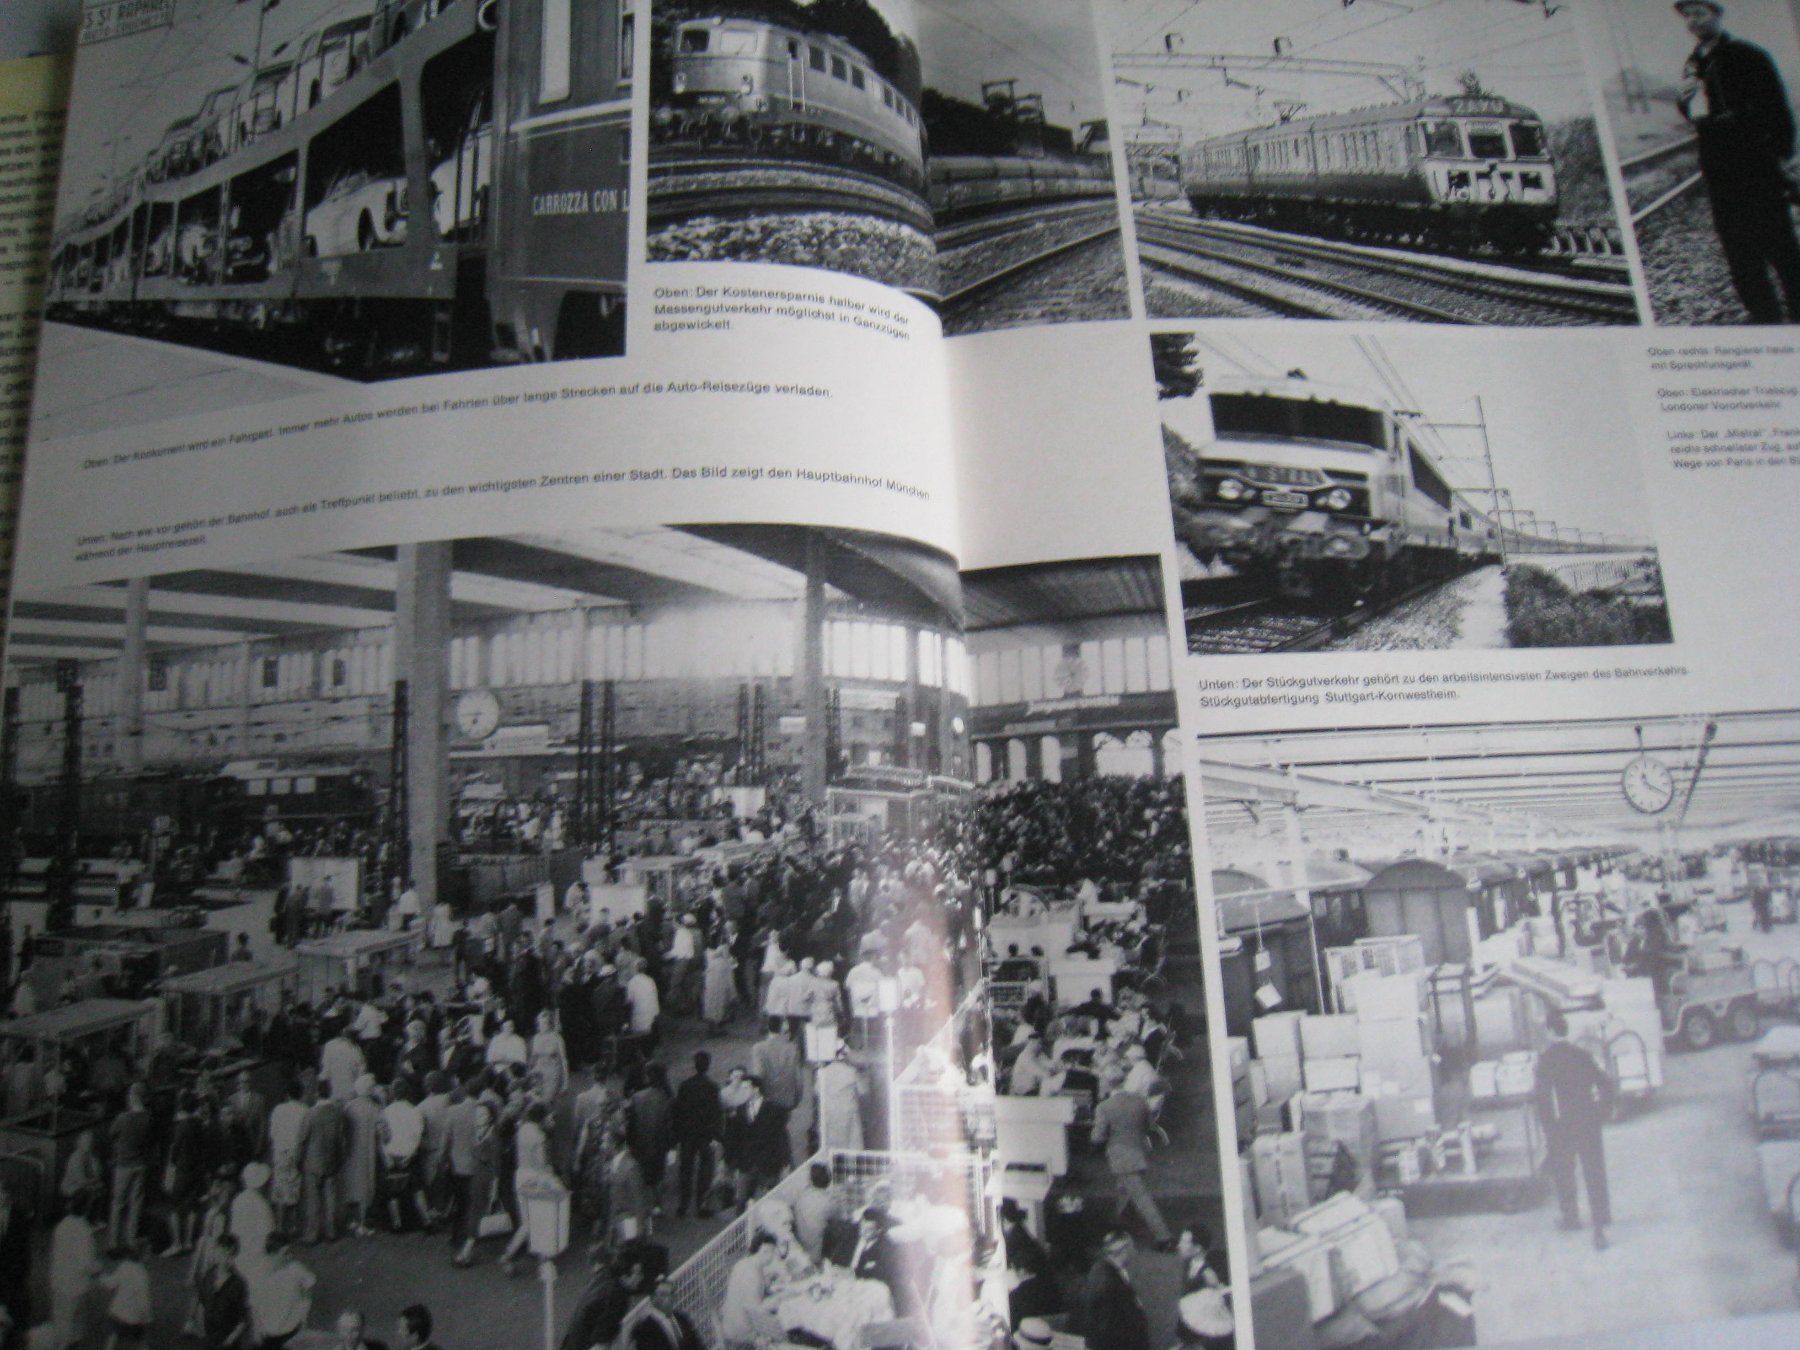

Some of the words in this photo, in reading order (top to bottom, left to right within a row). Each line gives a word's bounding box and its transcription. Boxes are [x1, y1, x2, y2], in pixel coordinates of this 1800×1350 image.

[533, 190, 589, 215] CARROZZA
[594, 189, 618, 213] CON
[654, 287, 692, 299] Oben:
[696, 286, 719, 298] Der
[723, 287, 825, 304] Kostenersparnis
[829, 295, 866, 311] halber
[869, 303, 891, 319] wird
[894, 312, 909, 325] der
[776, 305, 836, 321] möglichst
[839, 313, 850, 323] in
[853, 315, 911, 341] Ganzzügen
[314, 416, 340, 430] mehr
[343, 412, 373, 425] Autos
[377, 405, 418, 418] werden
[422, 402, 440, 413] bei
[443, 397, 489, 410] Fahrten
[493, 394, 520, 406] über
[524, 391, 557, 403] lange
[561, 384, 616, 399] Strecken
[619, 383, 640, 395] auf
[643, 382, 663, 393] die
[667, 380, 770, 395] Auto-Reisezüge
[774, 384, 833, 398] verladen.
[424, 487, 439, 498] zu
[442, 484, 465, 497] den
[468, 477, 537, 493] wichtigsten
[539, 473, 589, 488] Zentren
[593, 471, 626, 483] einer
[629, 466, 667, 481] Stadt.
[672, 467, 697, 479] Das
[701, 466, 728, 478] Bild
[730, 466, 763, 480] zeigt
[767, 466, 792, 479] den
[796, 468, 883, 488] Hauptbahnhof
[886, 479, 930, 501] München
[1199, 679, 1239, 691] Unten:
[1242, 677, 1263, 689] Der
[1266, 674, 1359, 689] Stückgutverkehr
[1362, 672, 1400, 687] gehört
[1402, 674, 1416, 684] zu
[1419, 672, 1439, 683] den
[1442, 670, 1541, 683] arbeitsintensivsten
[1544, 669, 1589, 682] Zweigen
[1592, 668, 1611, 679] des
[1199, 693, 1320, 709] Stückgutabfertigung
[1325, 688, 1461, 706] Stuttgart-Kornwestheim.
